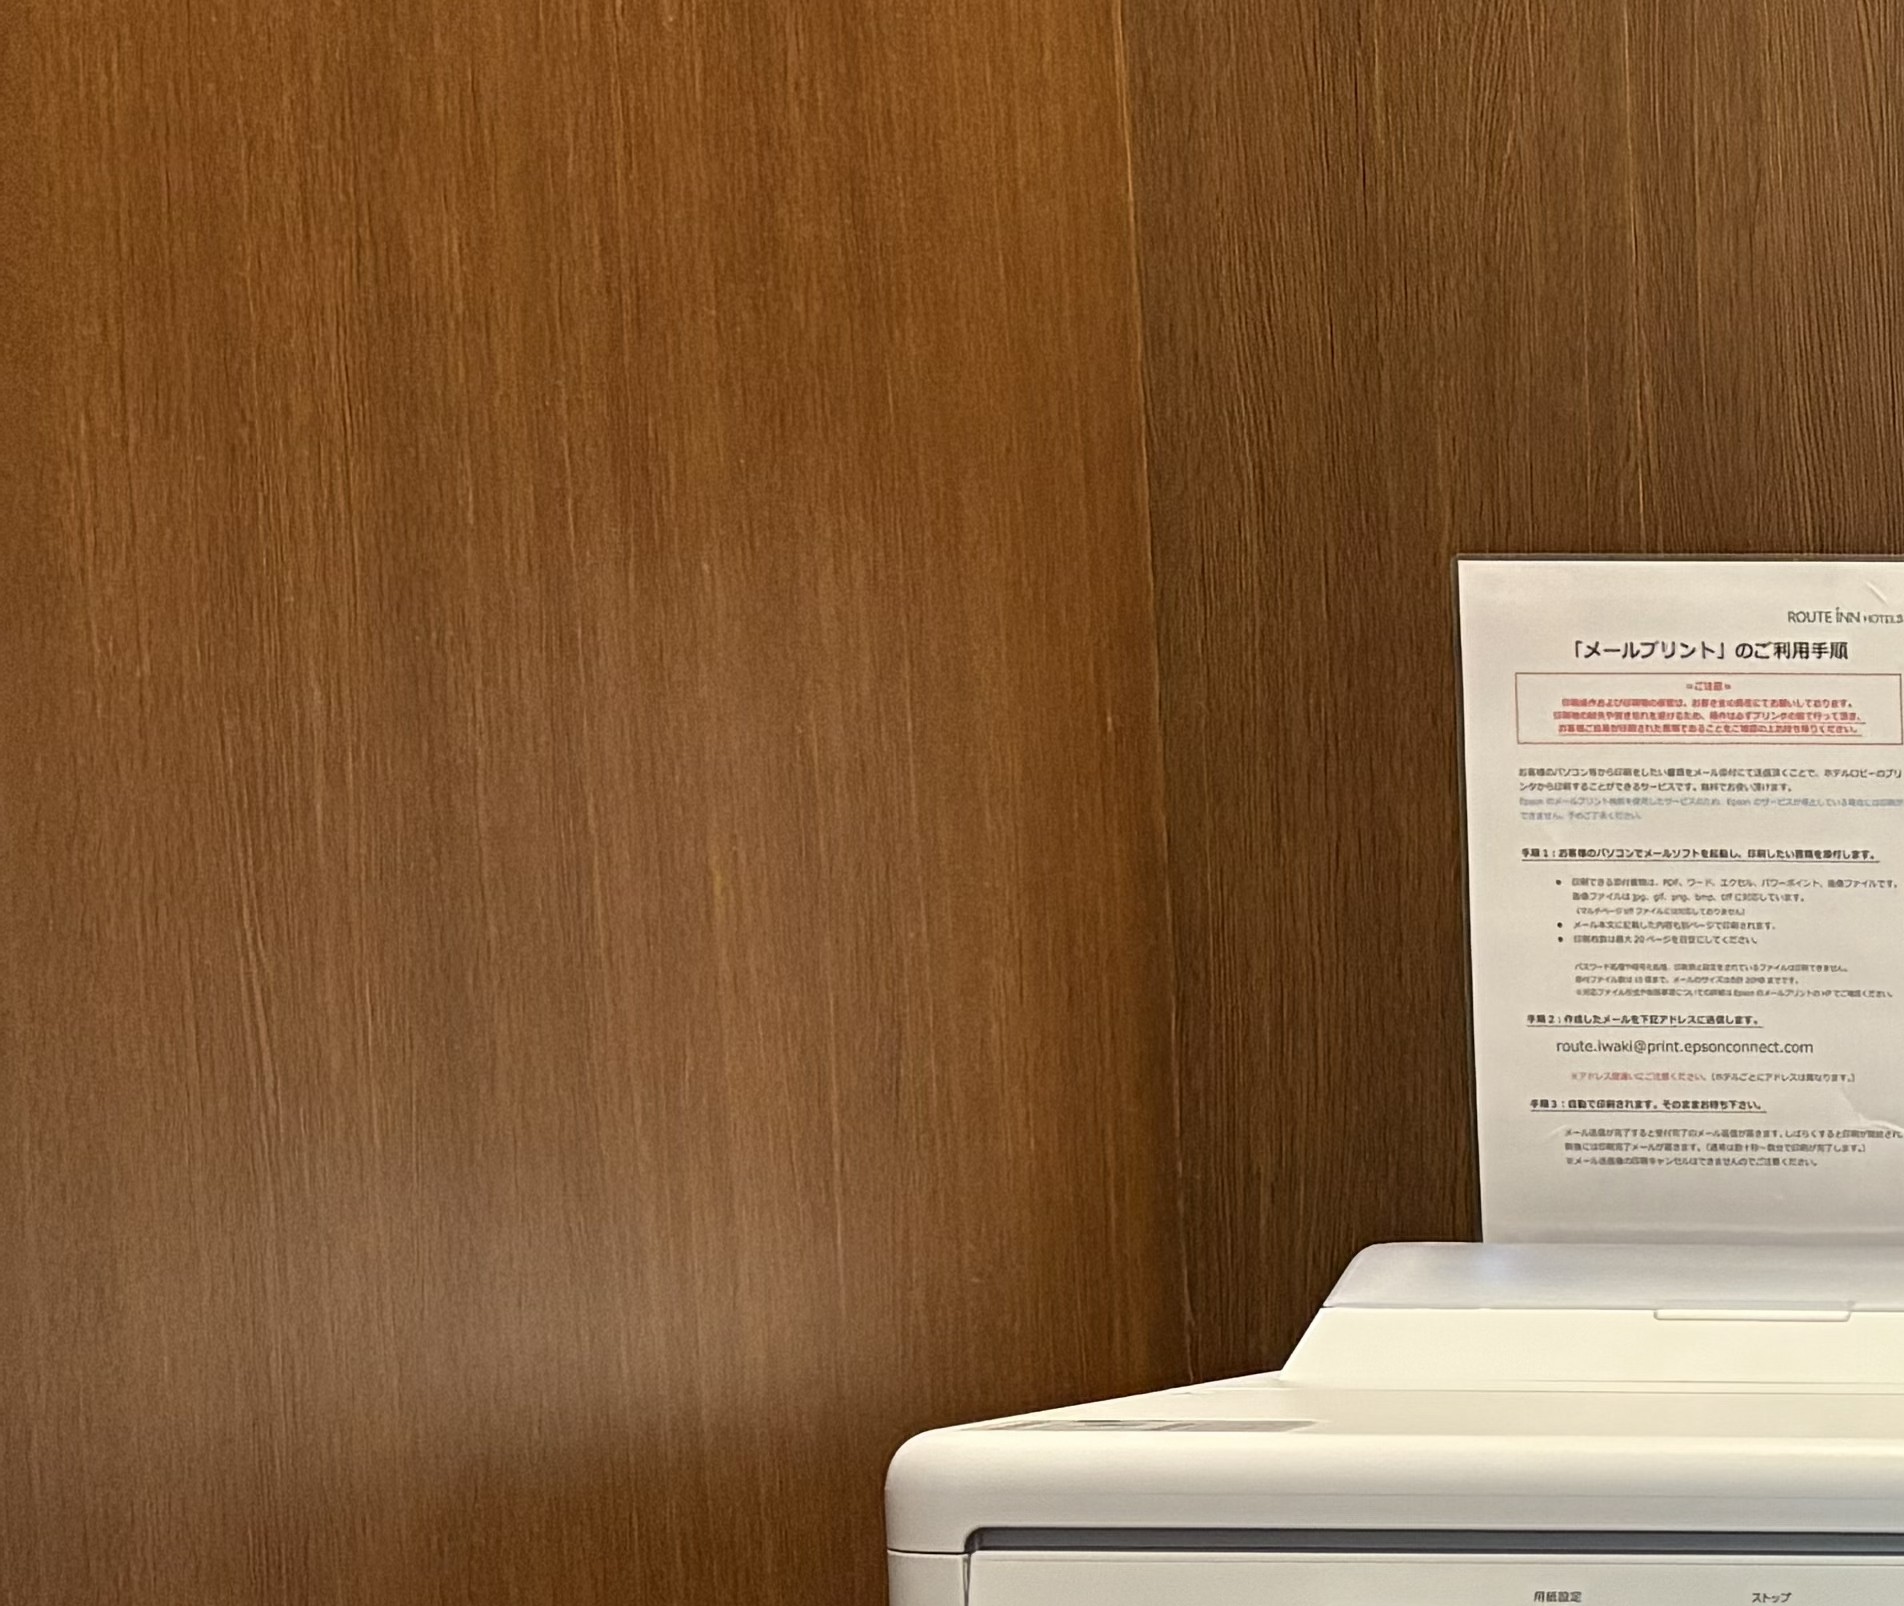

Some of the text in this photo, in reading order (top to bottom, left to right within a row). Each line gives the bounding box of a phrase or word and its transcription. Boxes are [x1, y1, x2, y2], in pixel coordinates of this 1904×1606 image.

[1788, 611, 1832, 624] ROUTE
[1574, 640, 1849, 660] 「メールプリント」のご利用手順
[1556, 1039, 1814, 1055] route.iwaki@print.epsonconnect.com
[1752, 1592, 1792, 1603] ストップ
